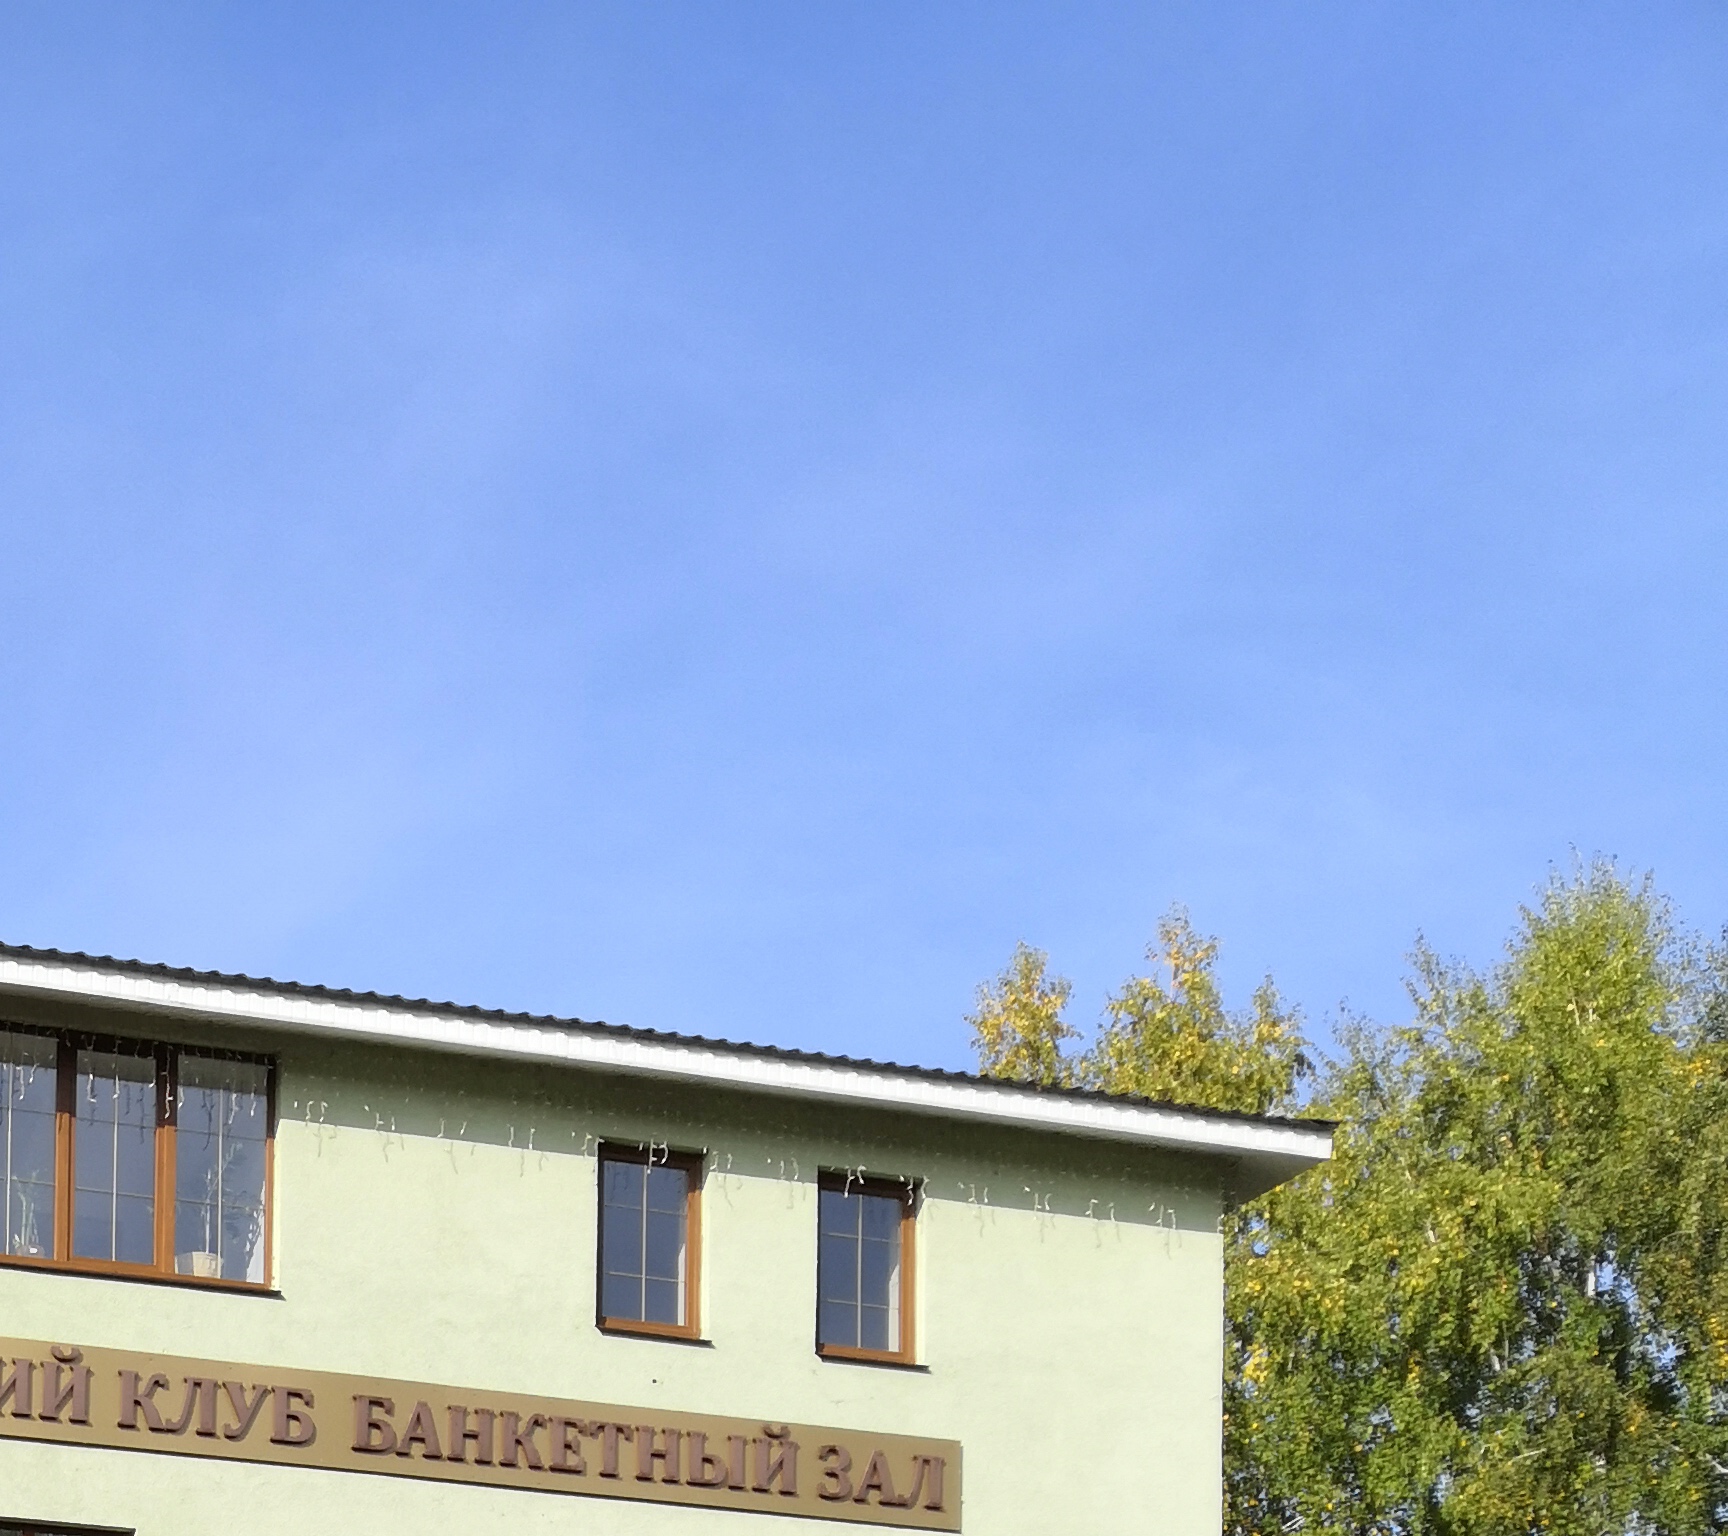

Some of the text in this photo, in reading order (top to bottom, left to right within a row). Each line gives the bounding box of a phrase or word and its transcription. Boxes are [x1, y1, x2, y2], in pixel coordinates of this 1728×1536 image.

[117, 1369, 317, 1447] КЛУБ
[351, 1393, 799, 1497] БАНКЕТНЫЙ
[818, 1444, 947, 1512] ЗАЛ
